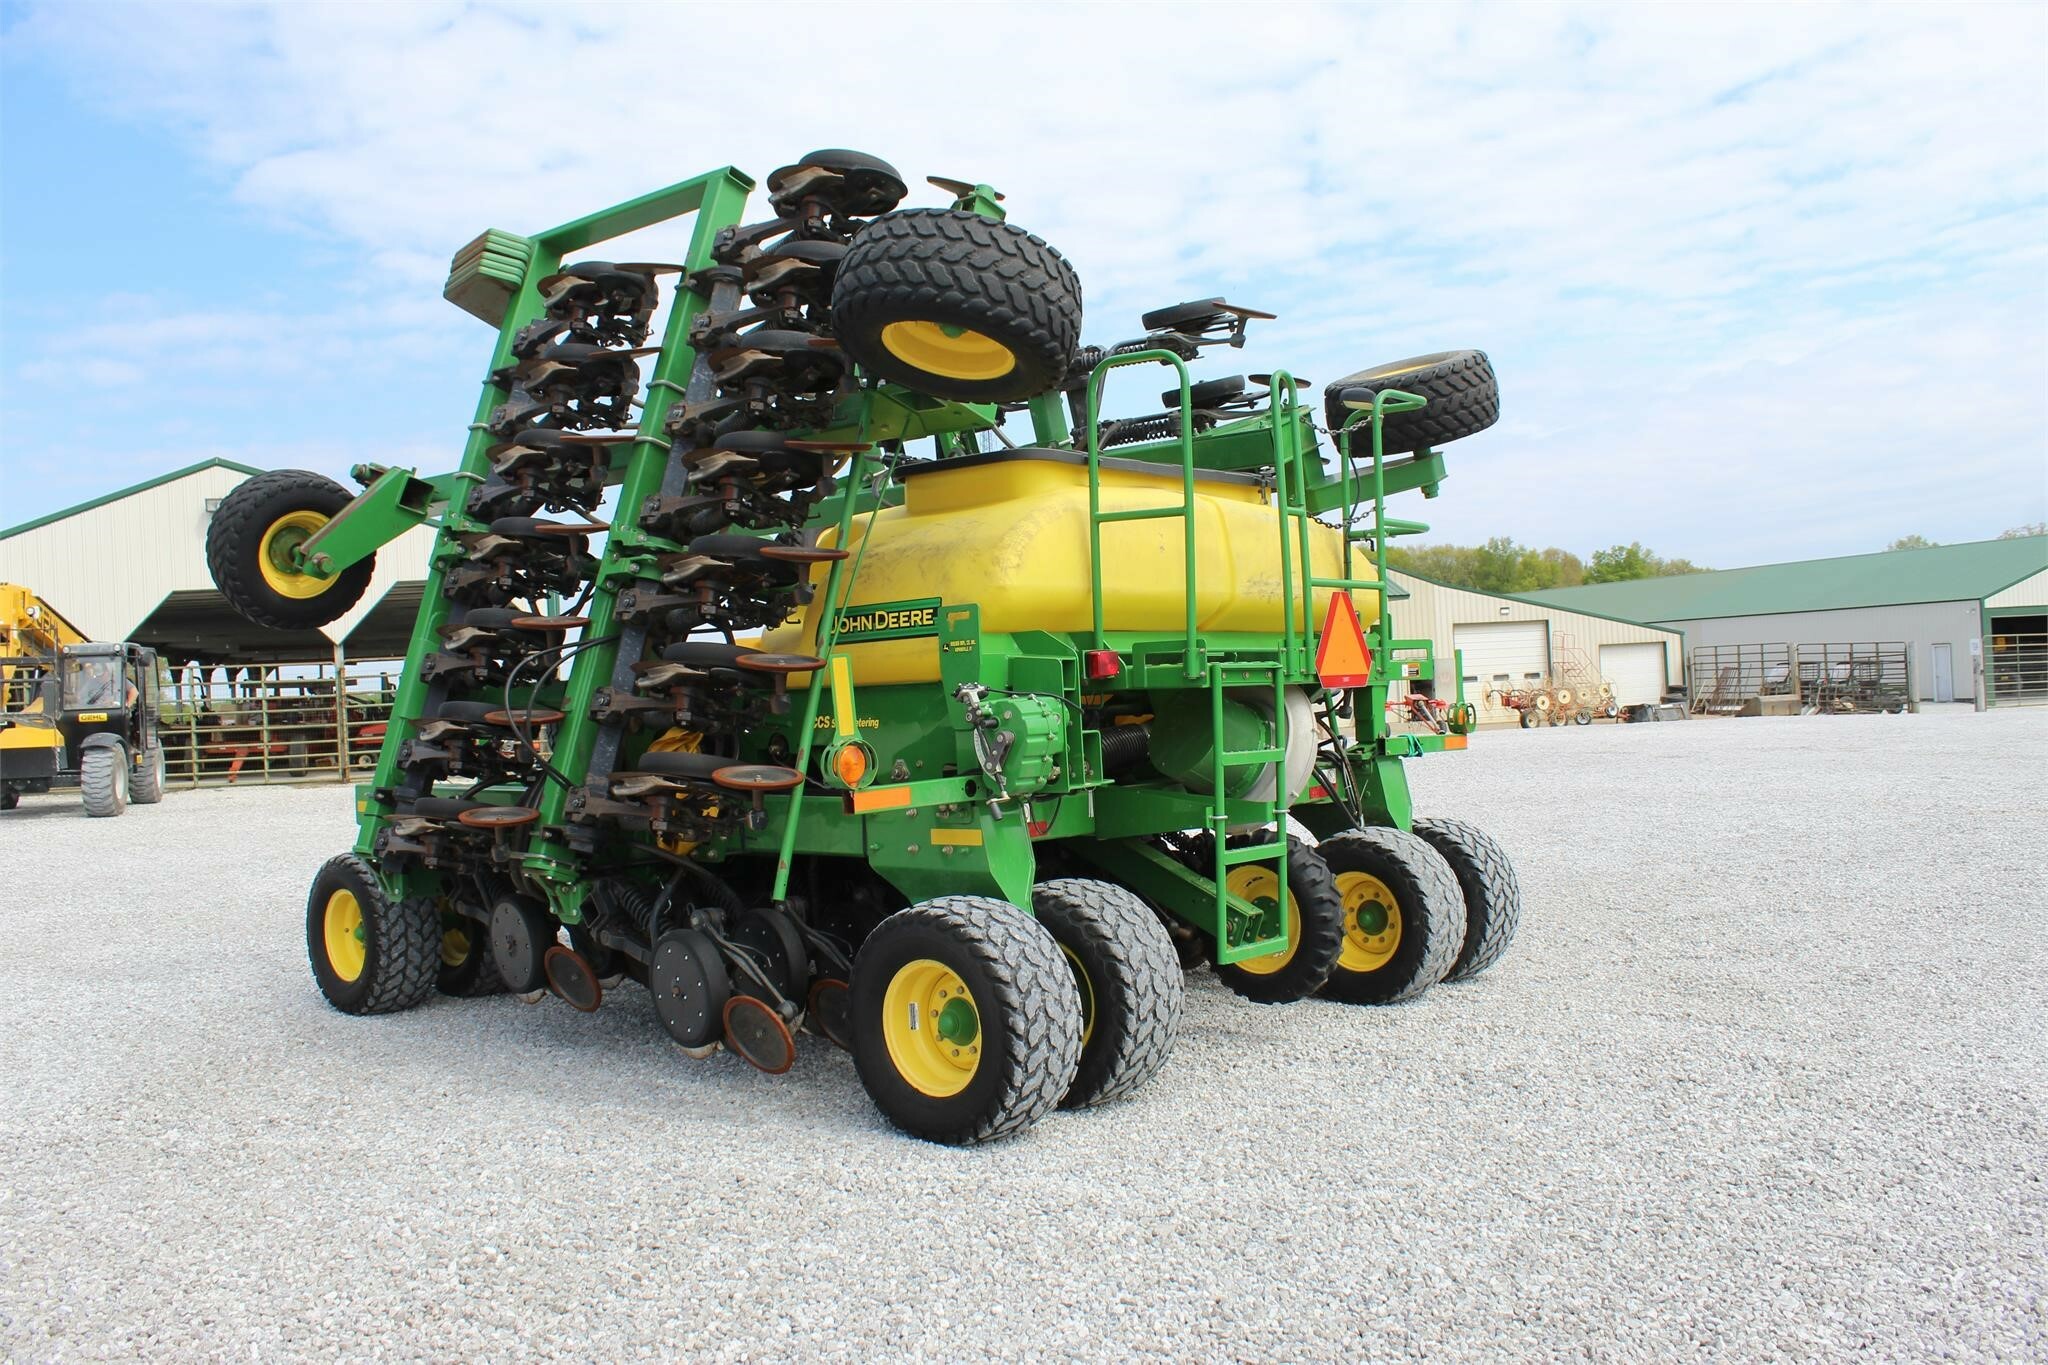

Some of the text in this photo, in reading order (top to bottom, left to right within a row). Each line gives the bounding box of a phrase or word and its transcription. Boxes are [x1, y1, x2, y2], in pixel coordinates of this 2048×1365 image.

[831, 608, 934, 635] JOHN DEERE
[856, 717, 880, 730] etering
